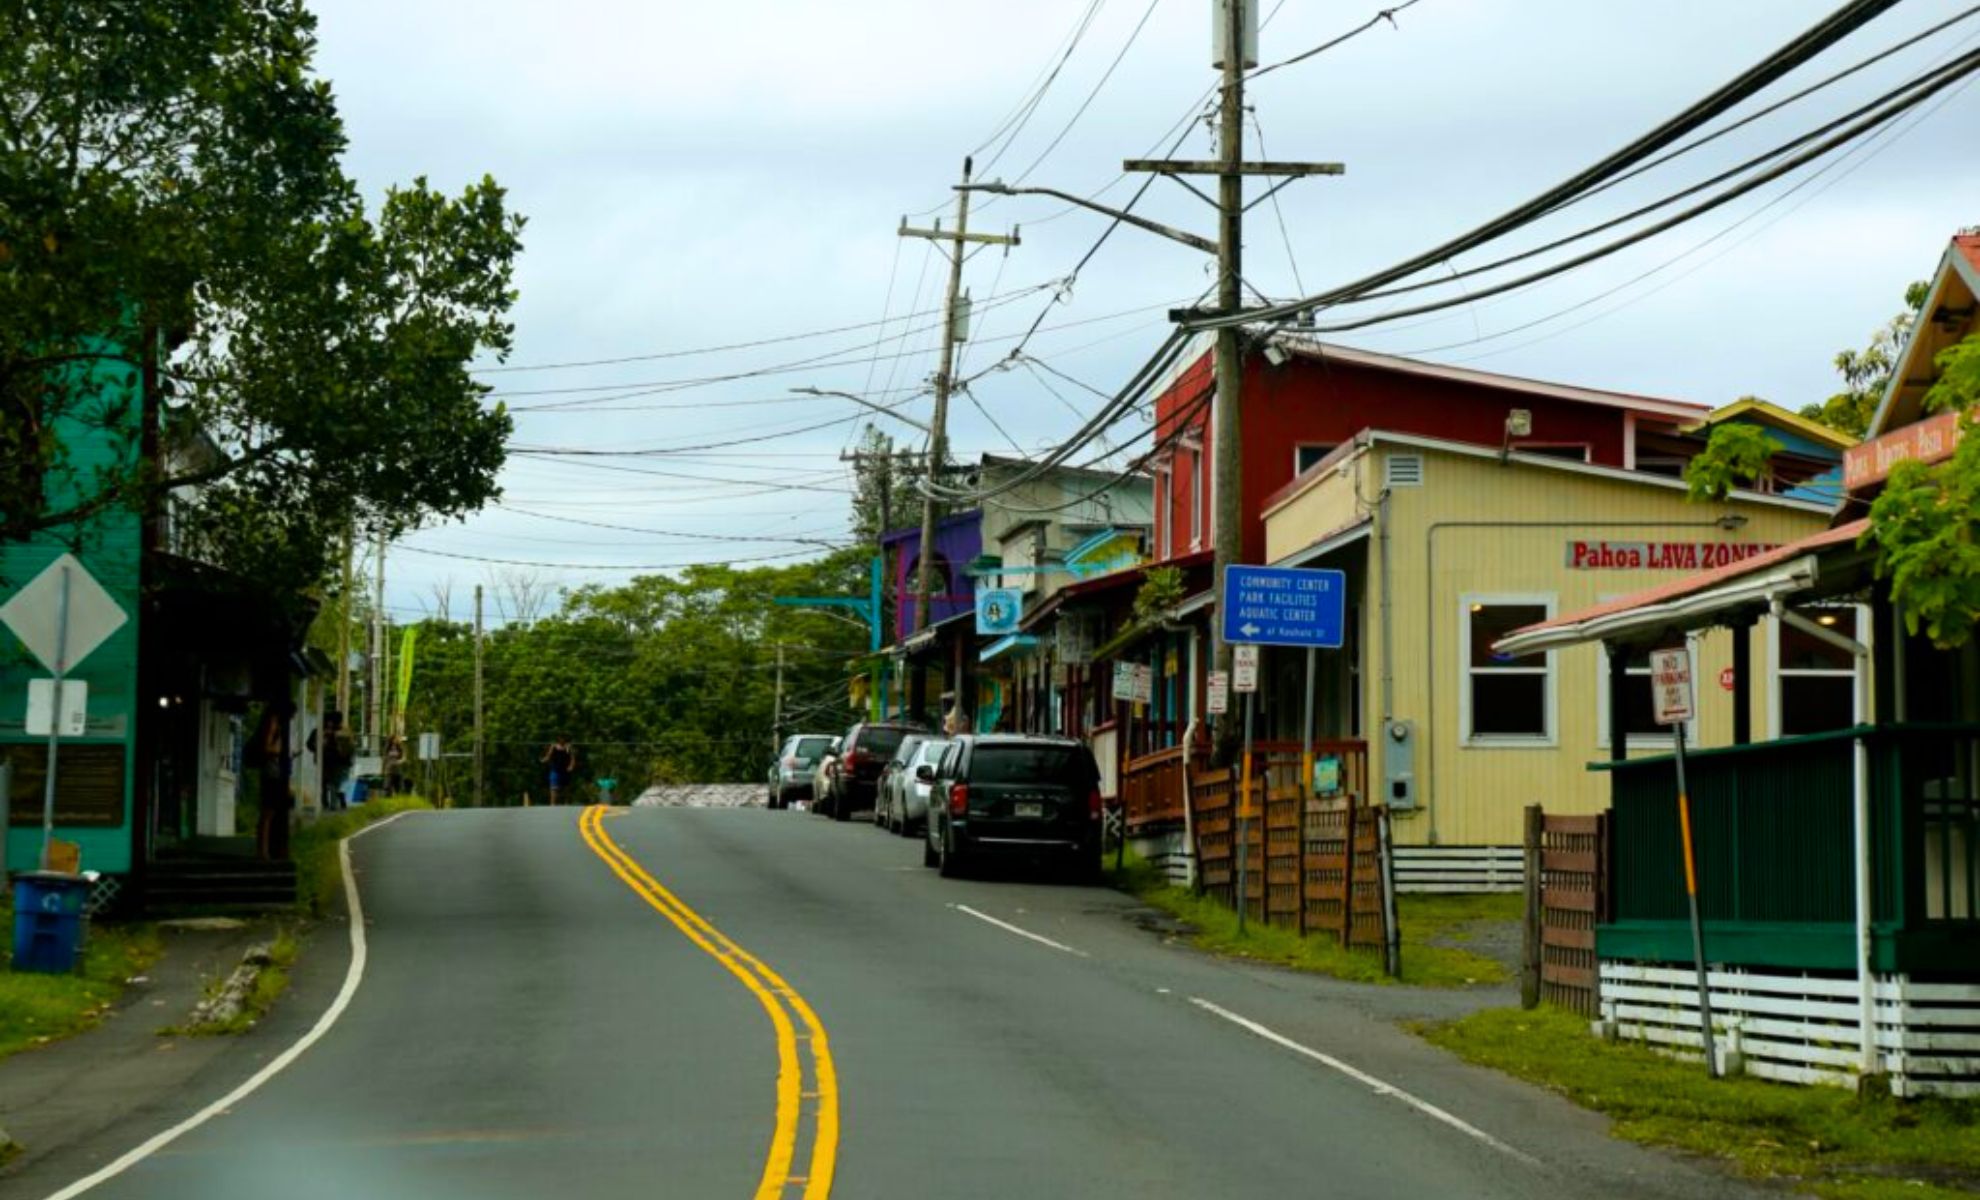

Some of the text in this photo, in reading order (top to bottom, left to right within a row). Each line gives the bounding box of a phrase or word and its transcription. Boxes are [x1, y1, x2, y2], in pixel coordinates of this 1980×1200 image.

[1573, 541, 1641, 568] Pahoa
[1647, 542, 1697, 569] LAVA
[1240, 576, 1329, 592] COMMUNITY CENTER
[1239, 591, 1317, 607] PARK FACILITIES
[1239, 607, 1316, 621] AQUATIC CENTER
[1662, 656, 1678, 670] NO
